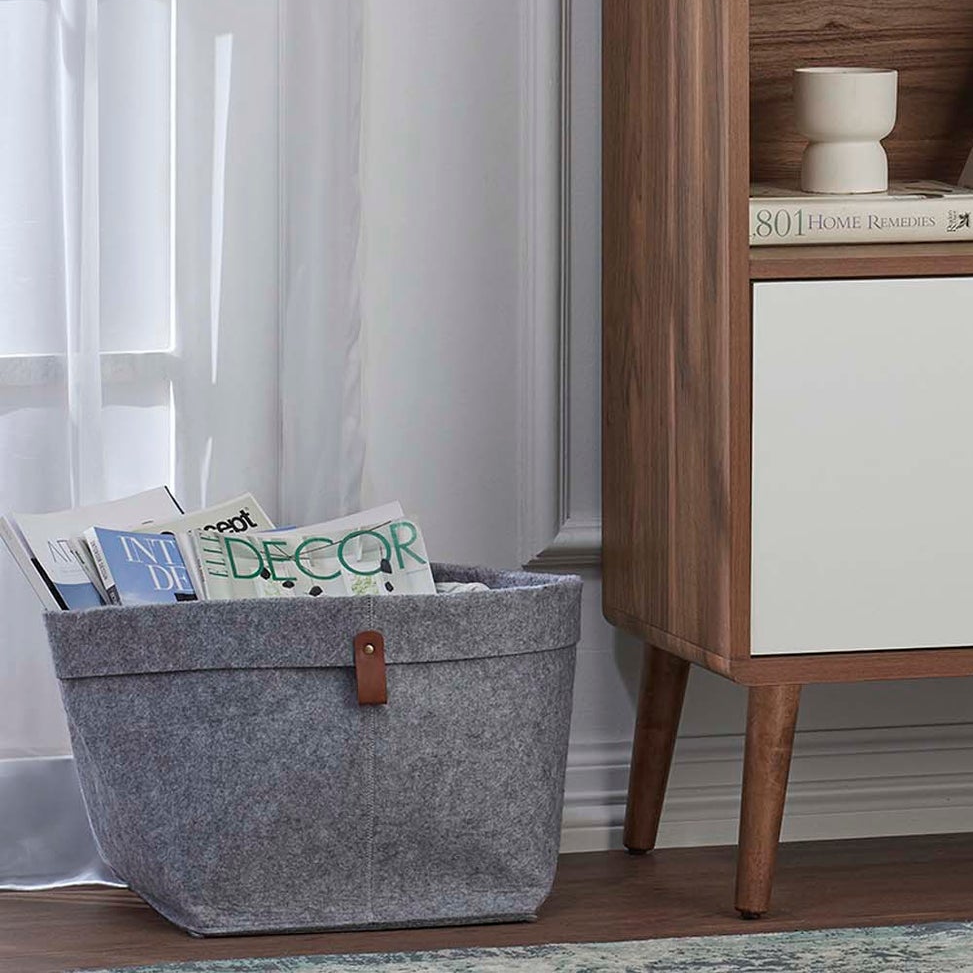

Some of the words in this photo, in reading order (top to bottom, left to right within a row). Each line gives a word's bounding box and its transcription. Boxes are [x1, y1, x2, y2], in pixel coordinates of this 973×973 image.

[748, 208, 807, 238] ,801
[808, 213, 862, 230] HOME
[868, 214, 936, 230] REMEDIES
[119, 535, 176, 563] INT
[224, 521, 427, 581] DECOR
[147, 563, 194, 591] DE
